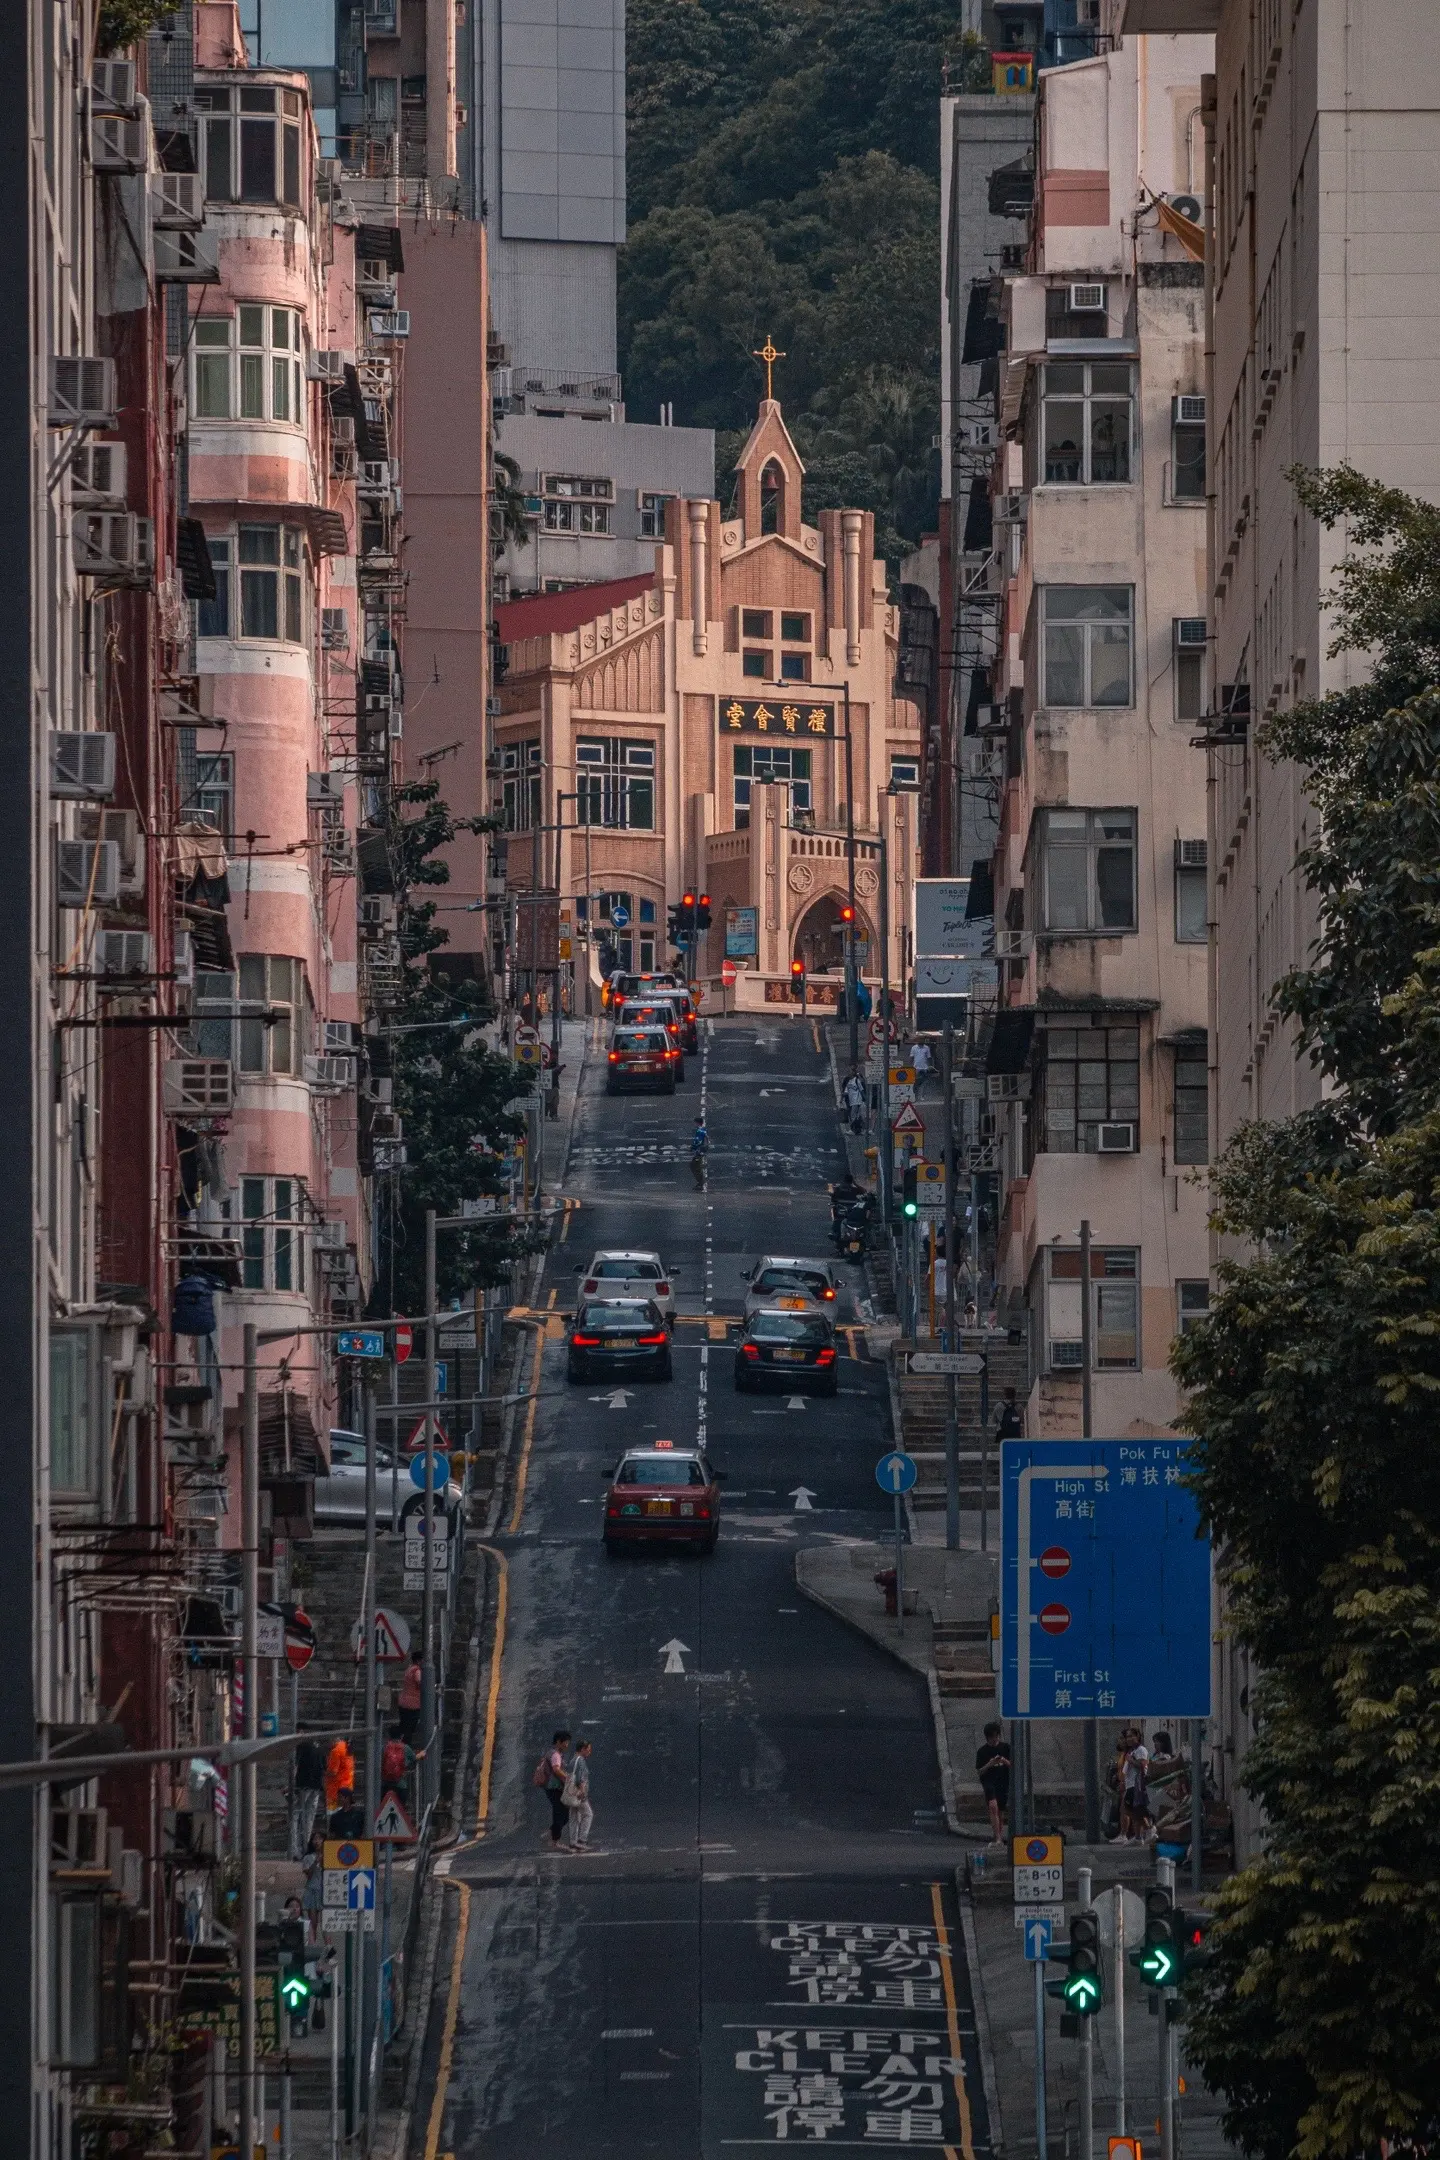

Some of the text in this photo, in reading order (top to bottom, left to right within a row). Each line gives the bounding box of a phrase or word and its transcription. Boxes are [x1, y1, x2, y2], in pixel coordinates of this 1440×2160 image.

[1119, 1447, 1145, 1460] Pok
[1153, 1447, 1171, 1459] Fu
[1055, 1480, 1110, 1495] High St
[1055, 1500, 1095, 1518] 高街
[1055, 1670, 1110, 1683] First St
[1055, 1689, 1116, 1709] 第一街
[1032, 1870, 1060, 1880] 8-10
[1033, 1886, 1055, 1897] 5-7
[788, 1924, 932, 1941] KEEP
[771, 1937, 952, 1956] CLEAR
[789, 1951, 941, 1980] 請勿
[786, 1976, 943, 2006] 停車
[757, 2030, 941, 2053] KEEP
[735, 2051, 967, 2076] CLEAR
[764, 2074, 944, 2110] 請勿
[764, 2106, 945, 2140] 停車
